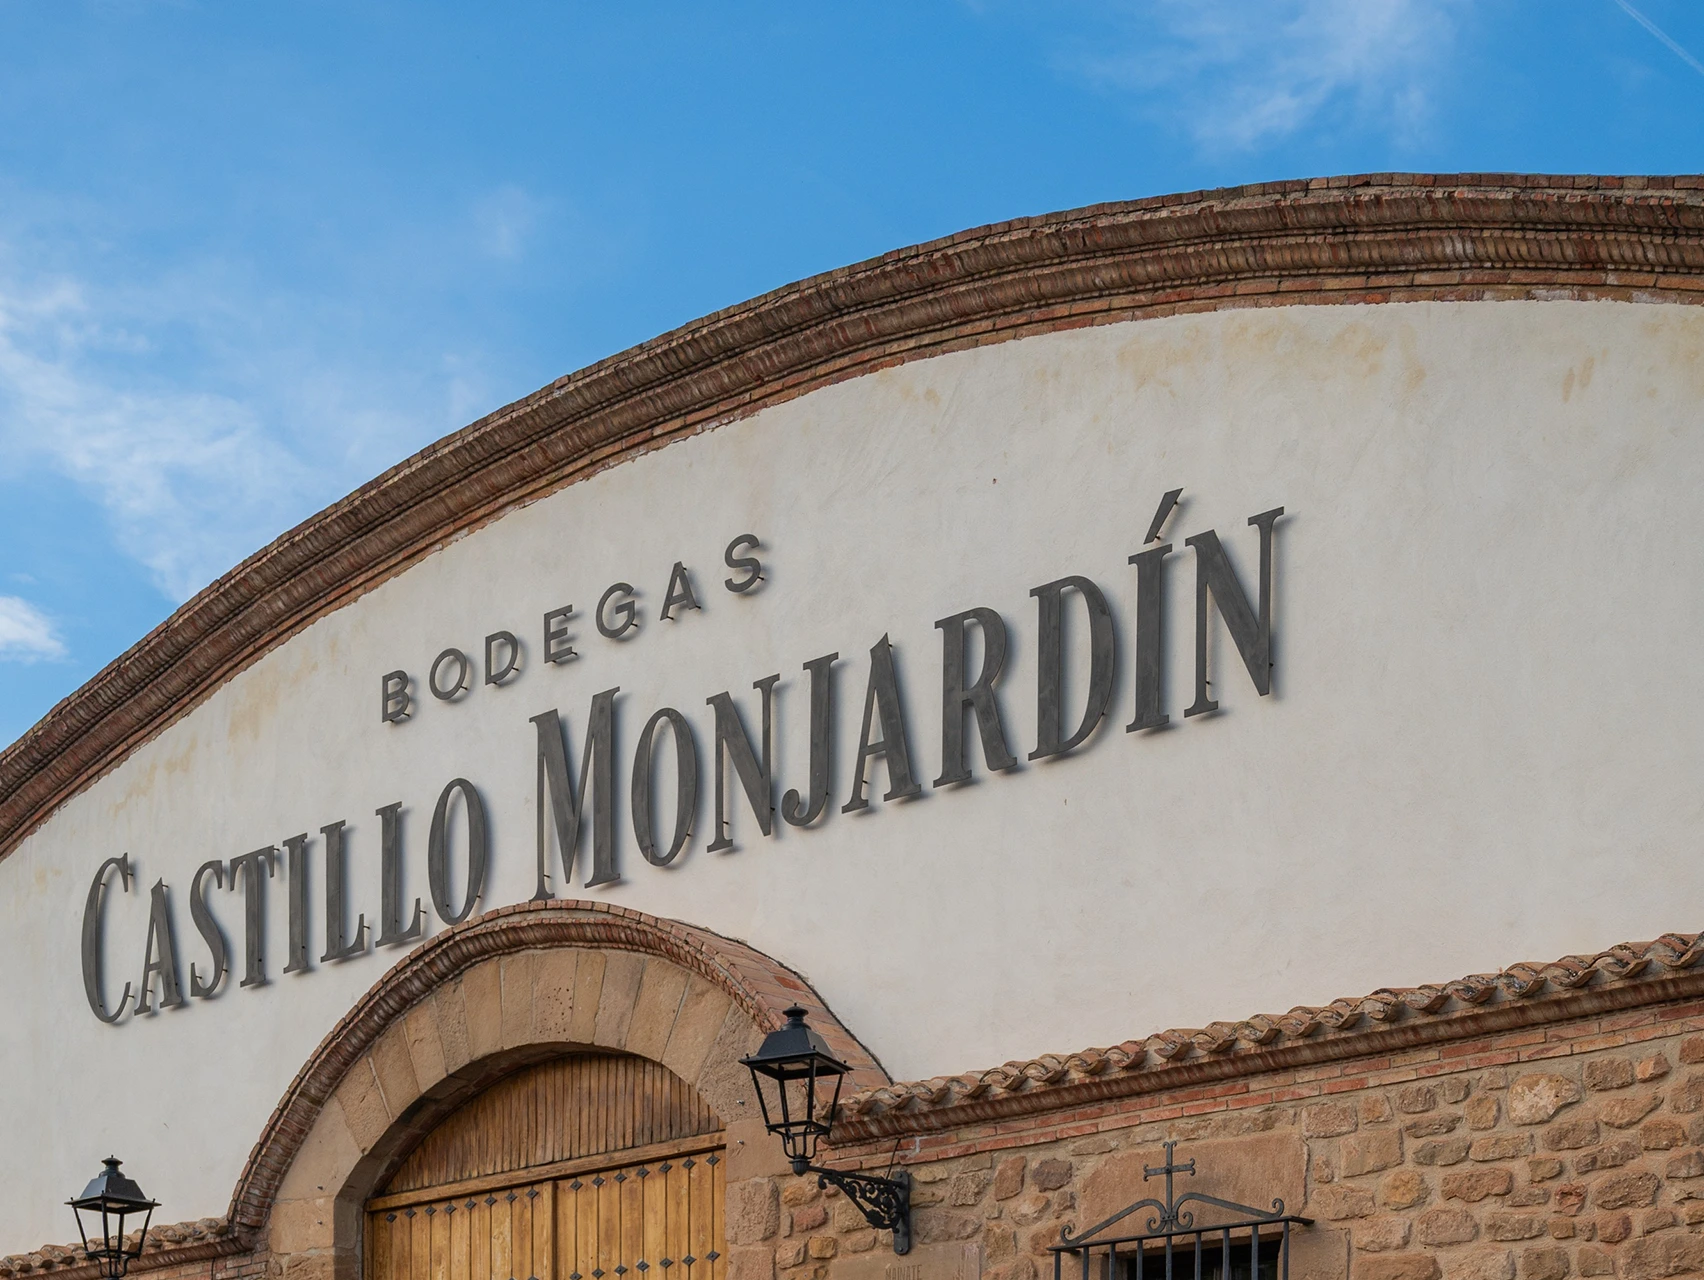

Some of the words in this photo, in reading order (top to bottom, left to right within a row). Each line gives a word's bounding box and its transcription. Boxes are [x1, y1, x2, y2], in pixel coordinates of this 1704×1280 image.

[81, 777, 487, 1024] CASTILLO
[528, 487, 1285, 902] MONJARDÍN
[382, 534, 763, 724] BODEGAS
